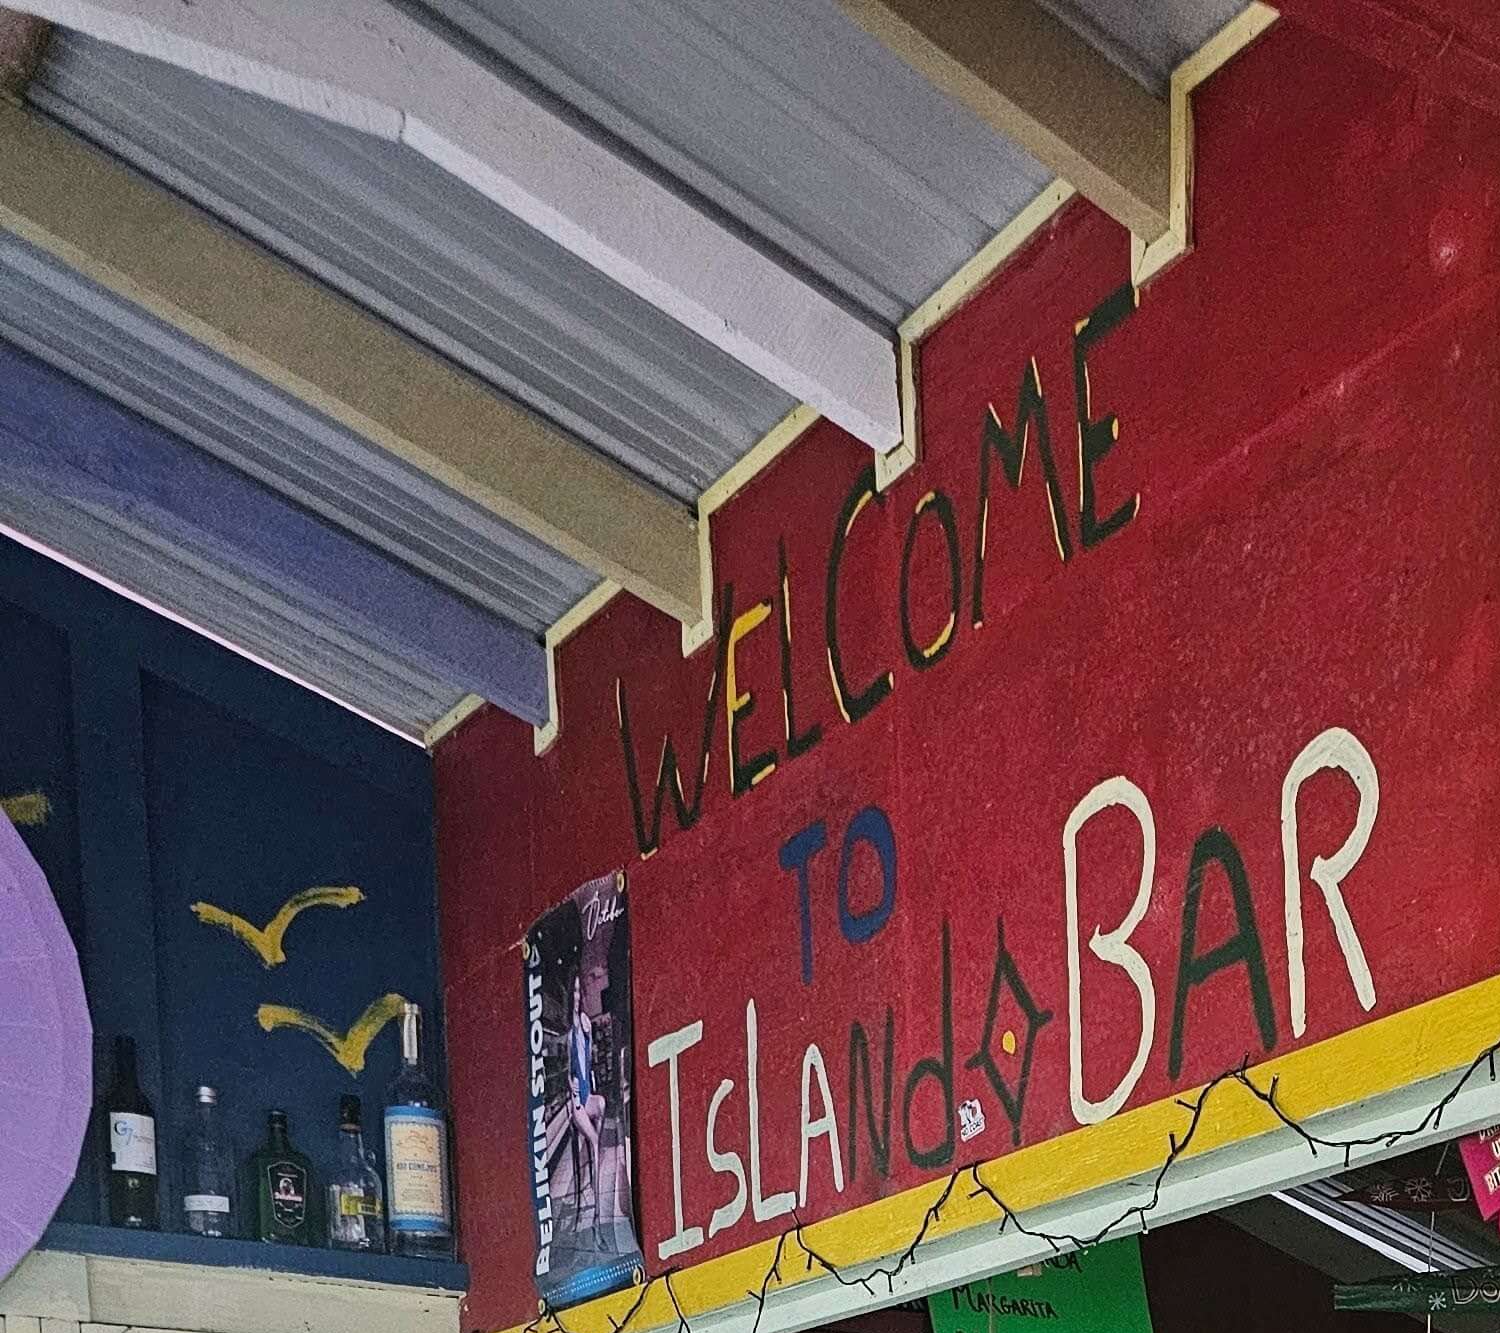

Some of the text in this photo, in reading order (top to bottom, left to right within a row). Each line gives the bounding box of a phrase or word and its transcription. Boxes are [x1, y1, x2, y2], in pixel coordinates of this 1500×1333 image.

[615, 284, 1144, 861] WELCOME
[778, 805, 899, 985] TO
[1062, 726, 1382, 1127] BAR
[527, 973, 552, 1277] BELIKIN STOUT
[952, 1285, 1059, 1320] MARGARITA
